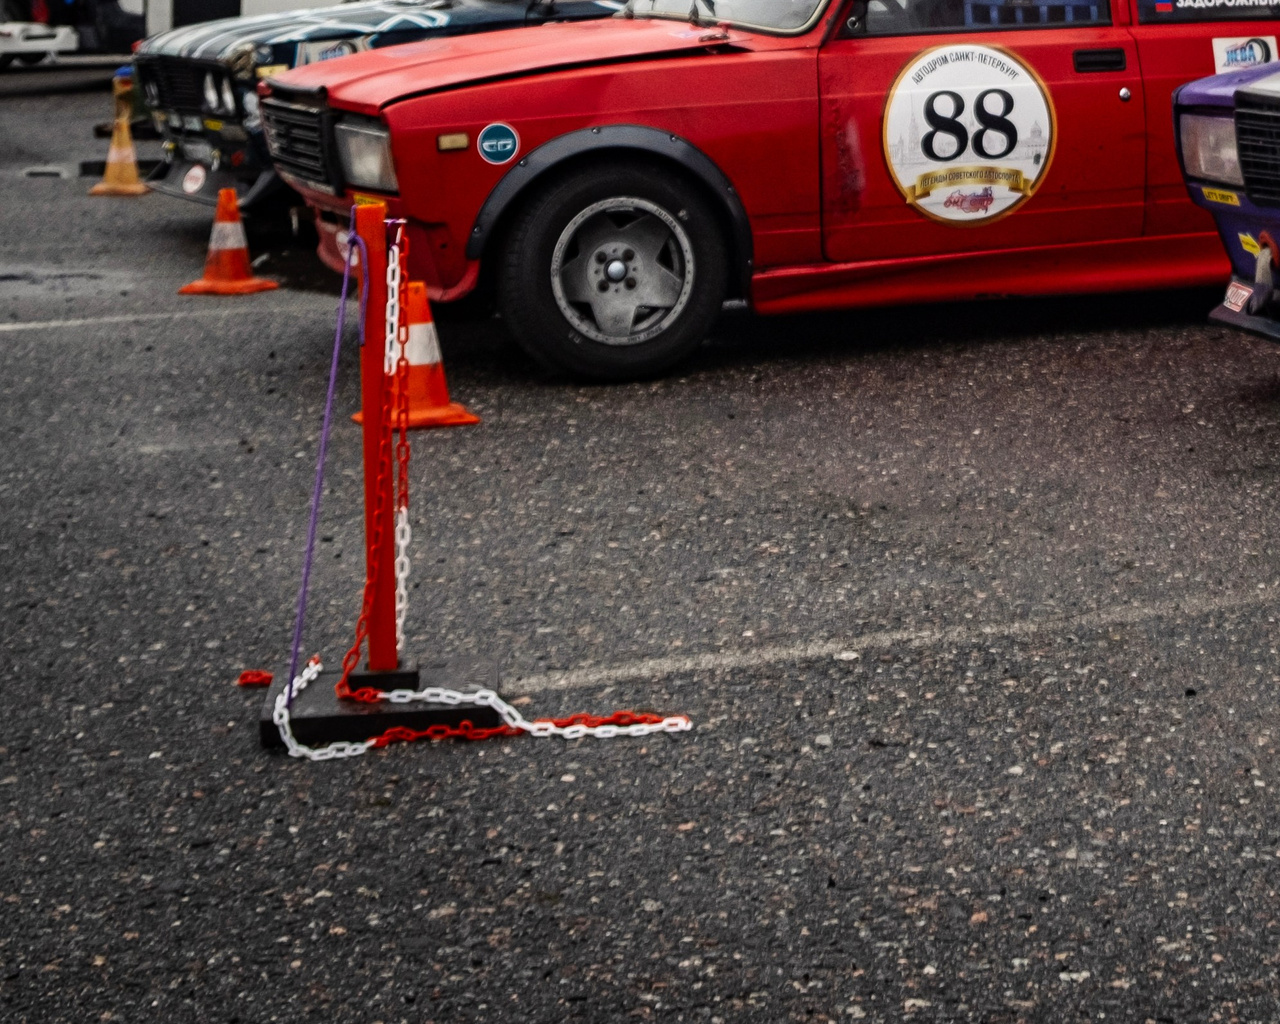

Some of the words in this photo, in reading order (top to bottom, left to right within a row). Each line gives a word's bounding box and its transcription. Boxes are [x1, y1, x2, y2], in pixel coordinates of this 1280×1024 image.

[912, 55, 949, 85] АВТОДРОМ
[949, 51, 1019, 80] САНКТ-ПЕТЕРБУРГ
[921, 88, 1018, 162] 88
[949, 170, 984, 181] СОВЕТСКОГО
